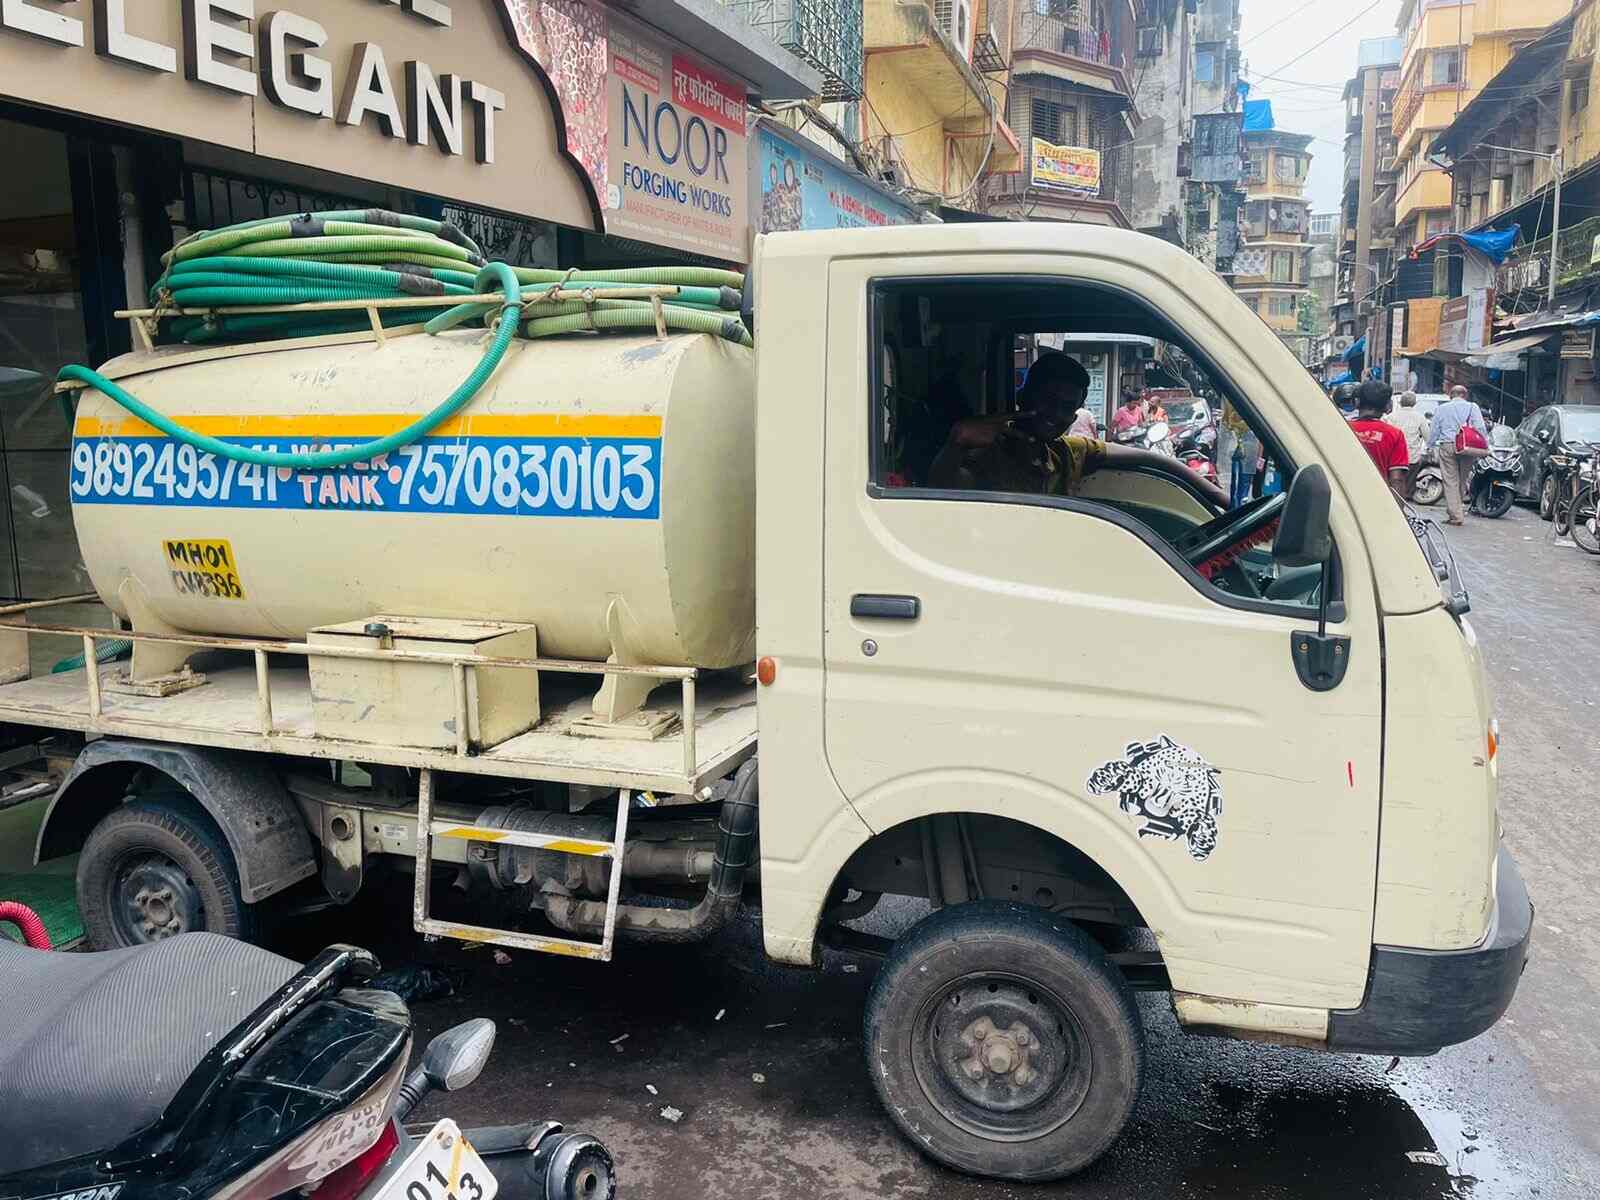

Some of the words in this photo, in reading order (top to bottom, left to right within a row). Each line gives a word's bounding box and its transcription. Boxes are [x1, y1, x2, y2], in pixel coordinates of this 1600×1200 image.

[623, 83, 730, 184] NOOR
[623, 160, 688, 204] FORGING
[690, 183, 732, 218] WORKS
[71, 441, 279, 501] 9892493741
[296, 474, 385, 506] TANK
[398, 444, 655, 512] 7570830103
